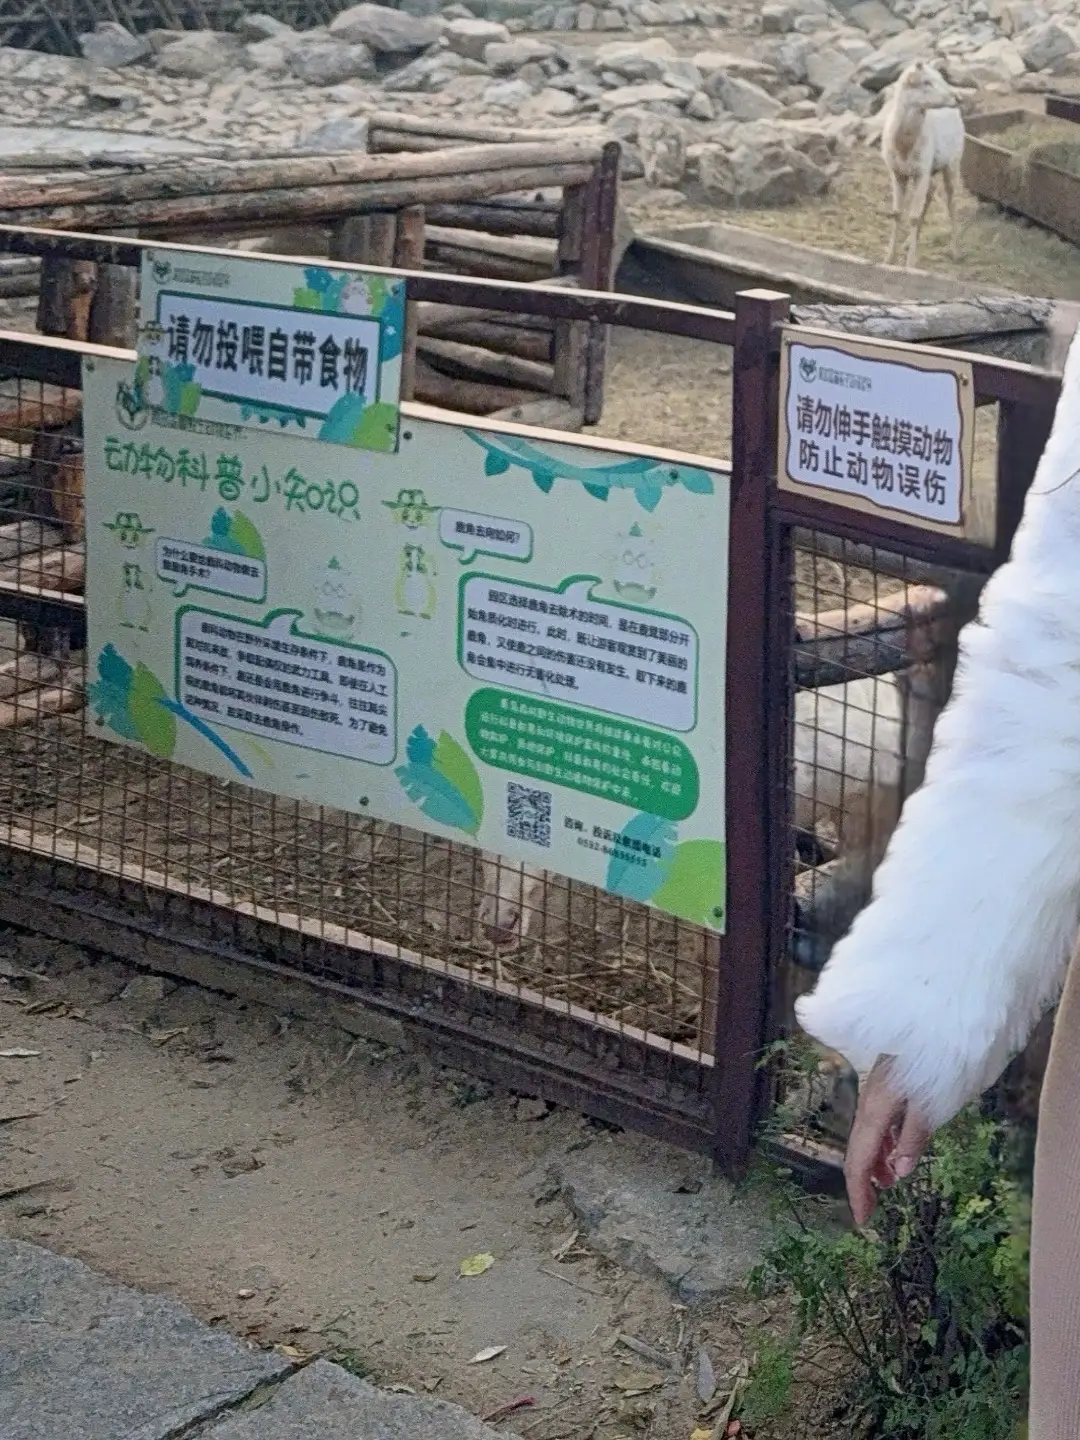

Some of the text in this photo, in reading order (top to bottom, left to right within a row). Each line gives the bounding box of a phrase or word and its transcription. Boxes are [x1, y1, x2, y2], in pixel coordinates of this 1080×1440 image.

[168, 314, 368, 394] 请勿投喂自带食物
[796, 394, 953, 466] 请勿伸手触摸动物
[104, 436, 361, 520] 动物科普小知识
[799, 439, 946, 505] 防止动物误伤
